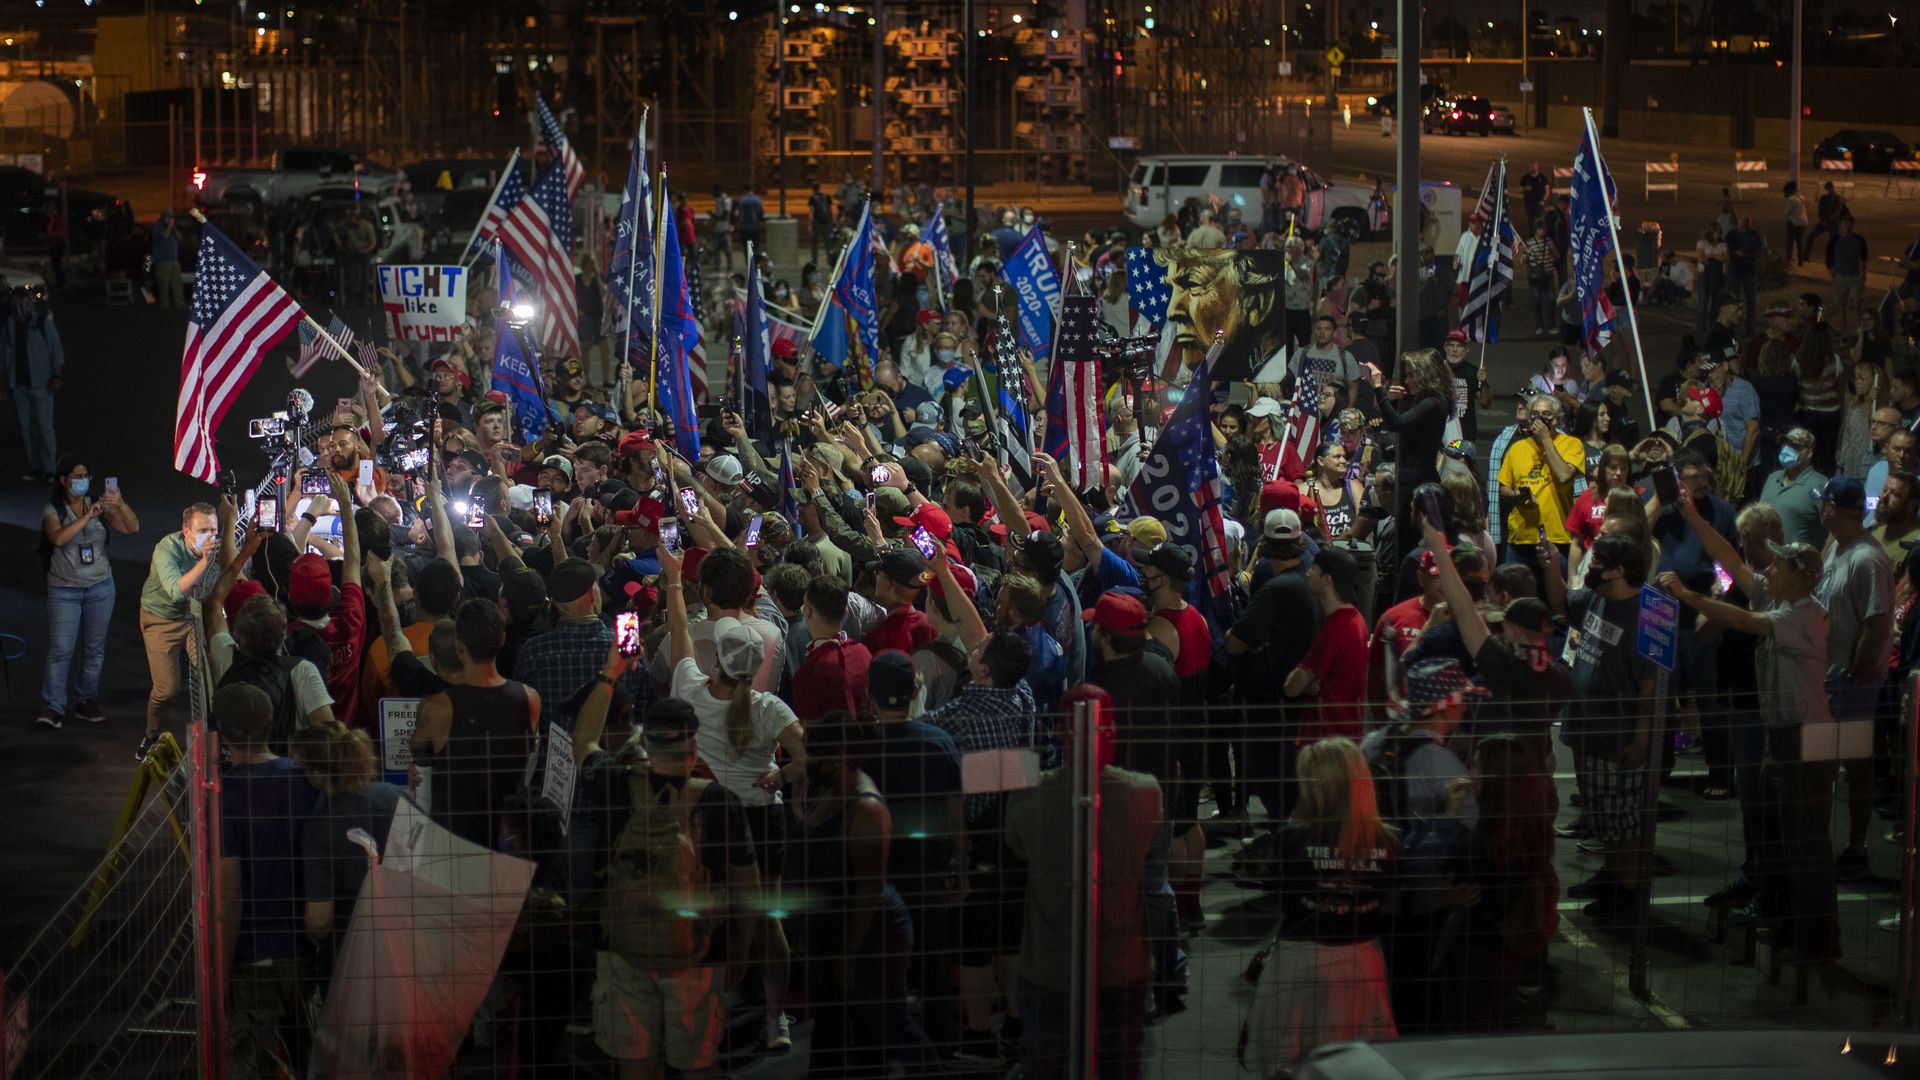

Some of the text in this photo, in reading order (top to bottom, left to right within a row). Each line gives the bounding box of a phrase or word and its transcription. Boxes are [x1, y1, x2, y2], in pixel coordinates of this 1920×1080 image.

[379, 267, 463, 297] FIGHT
[1024, 239, 1061, 317] TRUM
[405, 297, 437, 313] like
[388, 711, 417, 719] FREE
